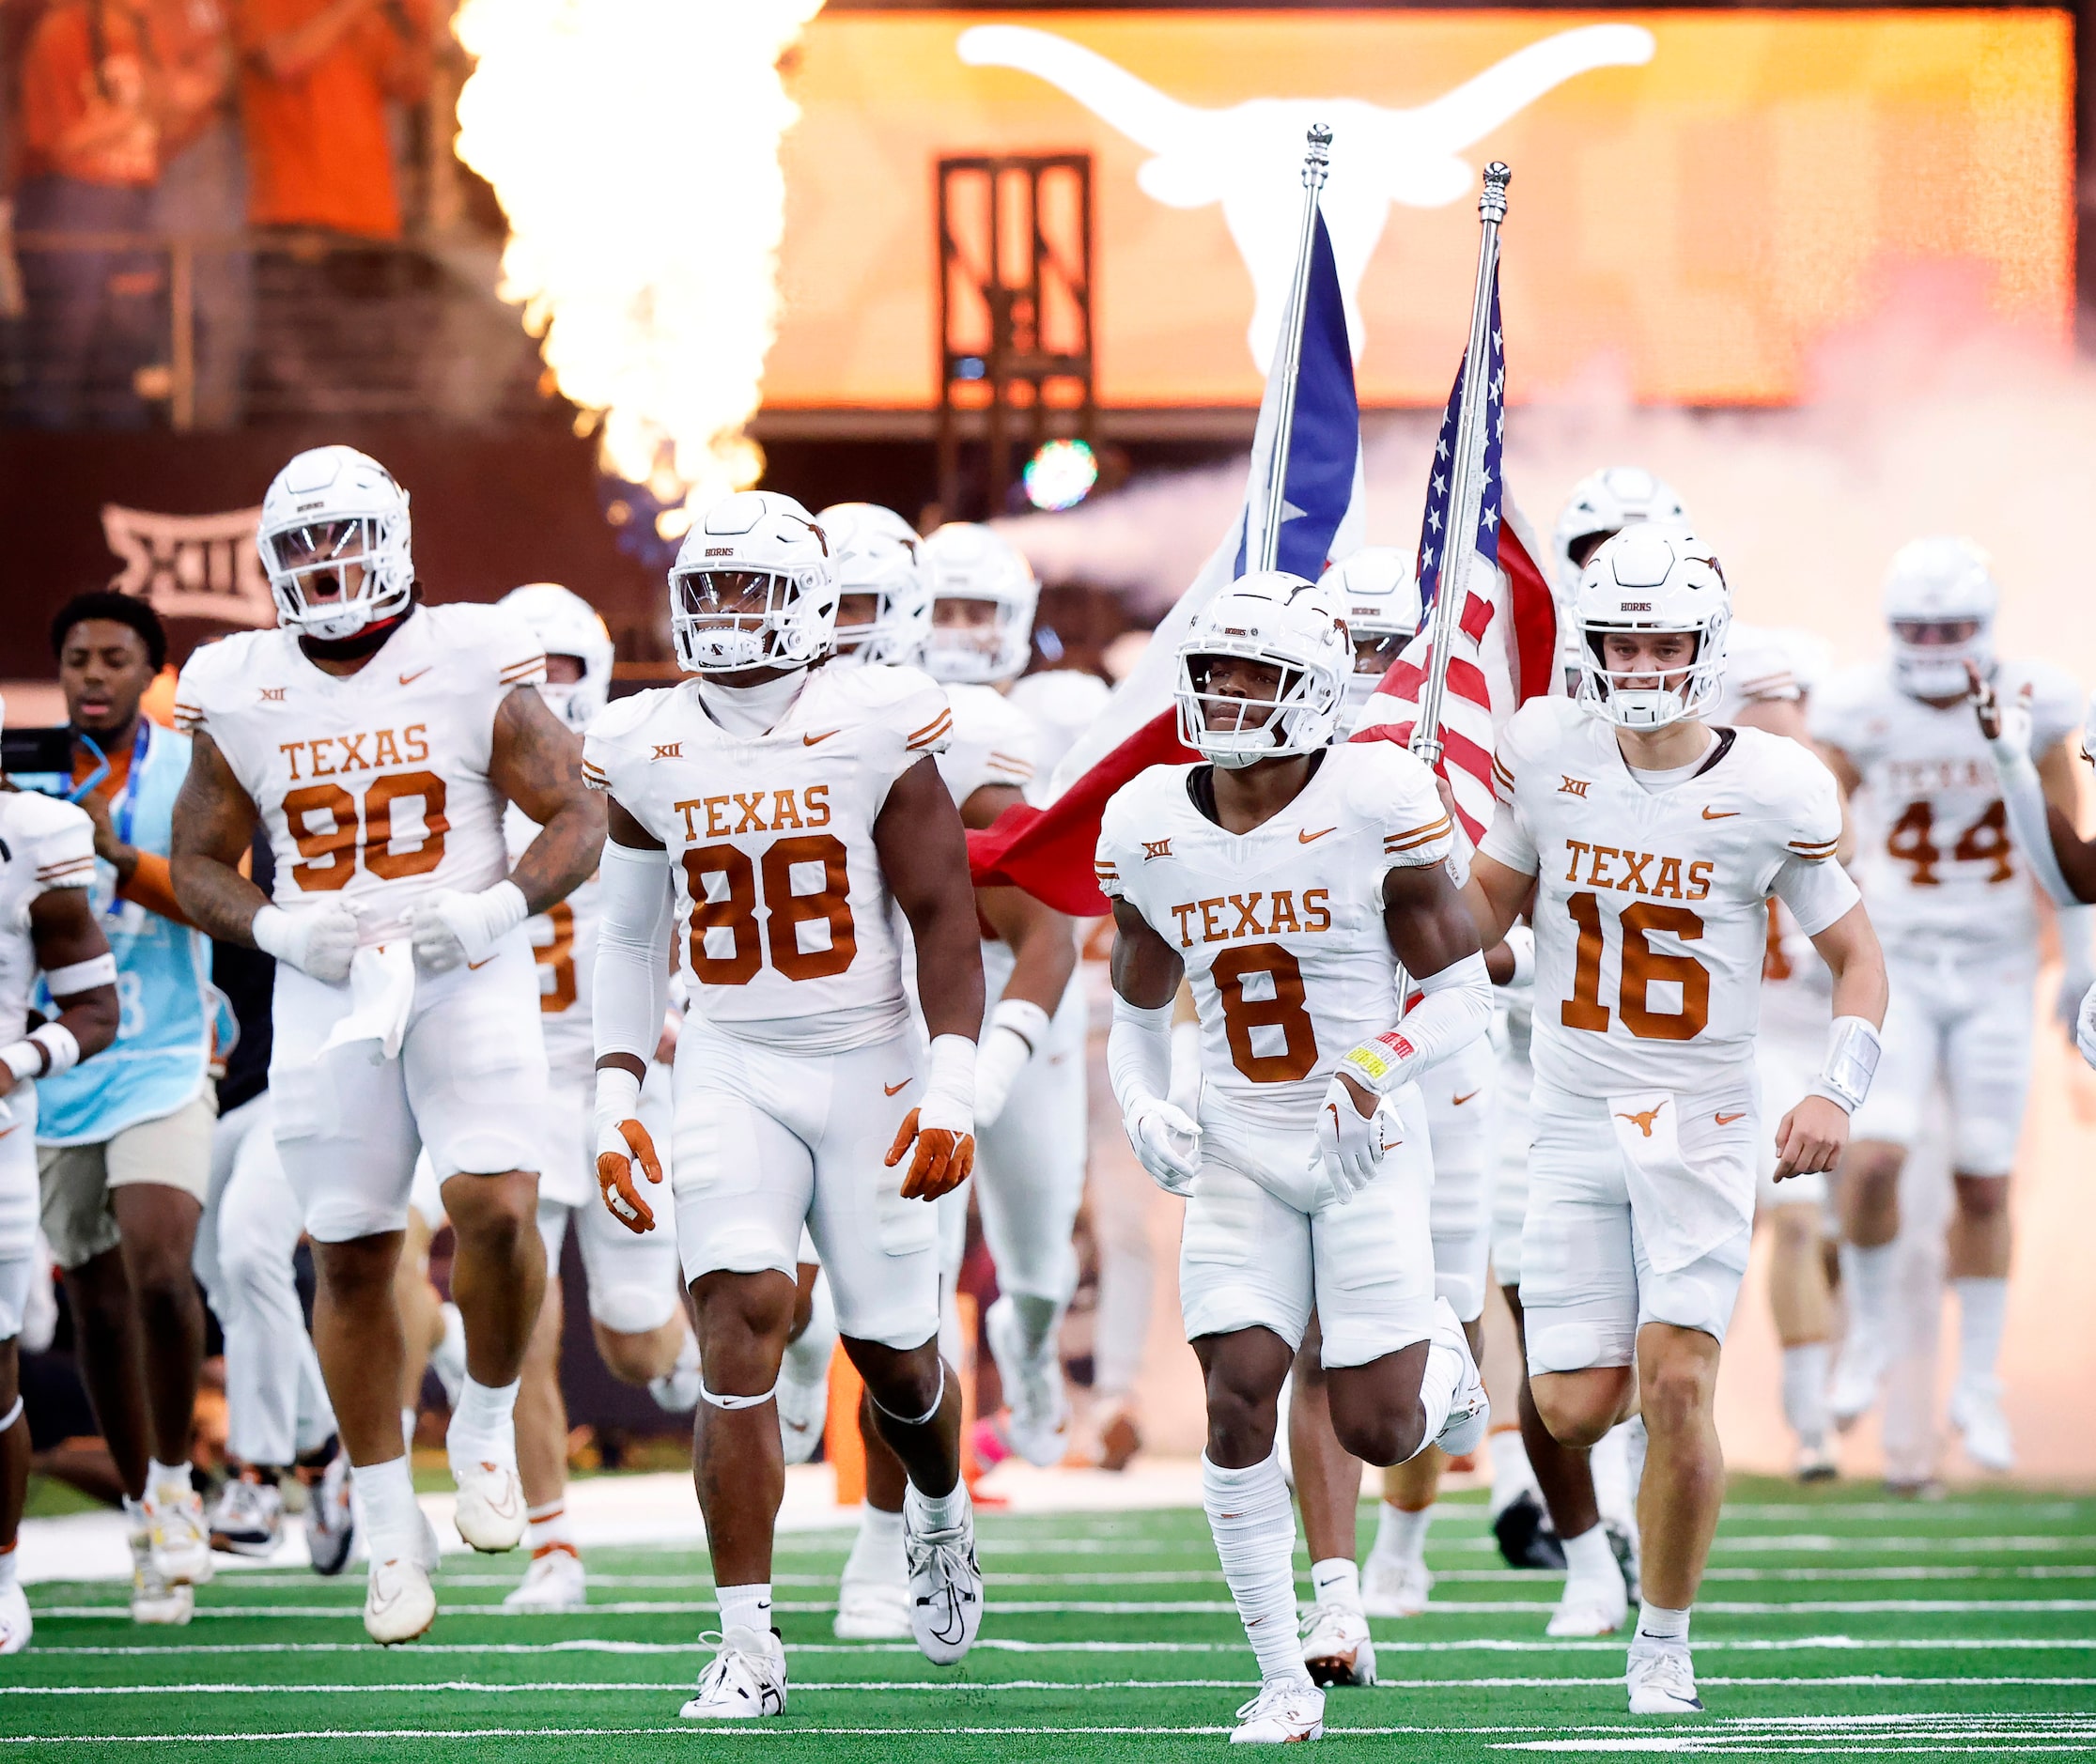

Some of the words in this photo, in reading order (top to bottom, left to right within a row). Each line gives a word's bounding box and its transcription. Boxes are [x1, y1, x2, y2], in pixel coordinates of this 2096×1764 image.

[705, 548, 734, 557] HORNS
[1621, 602, 1652, 611] HORNS
[260, 688, 286, 701] XII
[279, 723, 429, 781] TEXAS
[651, 741, 682, 760] XII
[675, 784, 831, 842] TEXAS
[1558, 774, 1591, 798] XII
[282, 769, 451, 892] 90
[1141, 838, 1172, 860] XII
[1887, 800, 2014, 885] 44
[1566, 841, 1714, 901] TEXAS
[682, 833, 858, 985] 88
[1172, 889, 1331, 948] TEXAS
[1561, 891, 1710, 1041] 16
[1210, 943, 1318, 1083] 8
